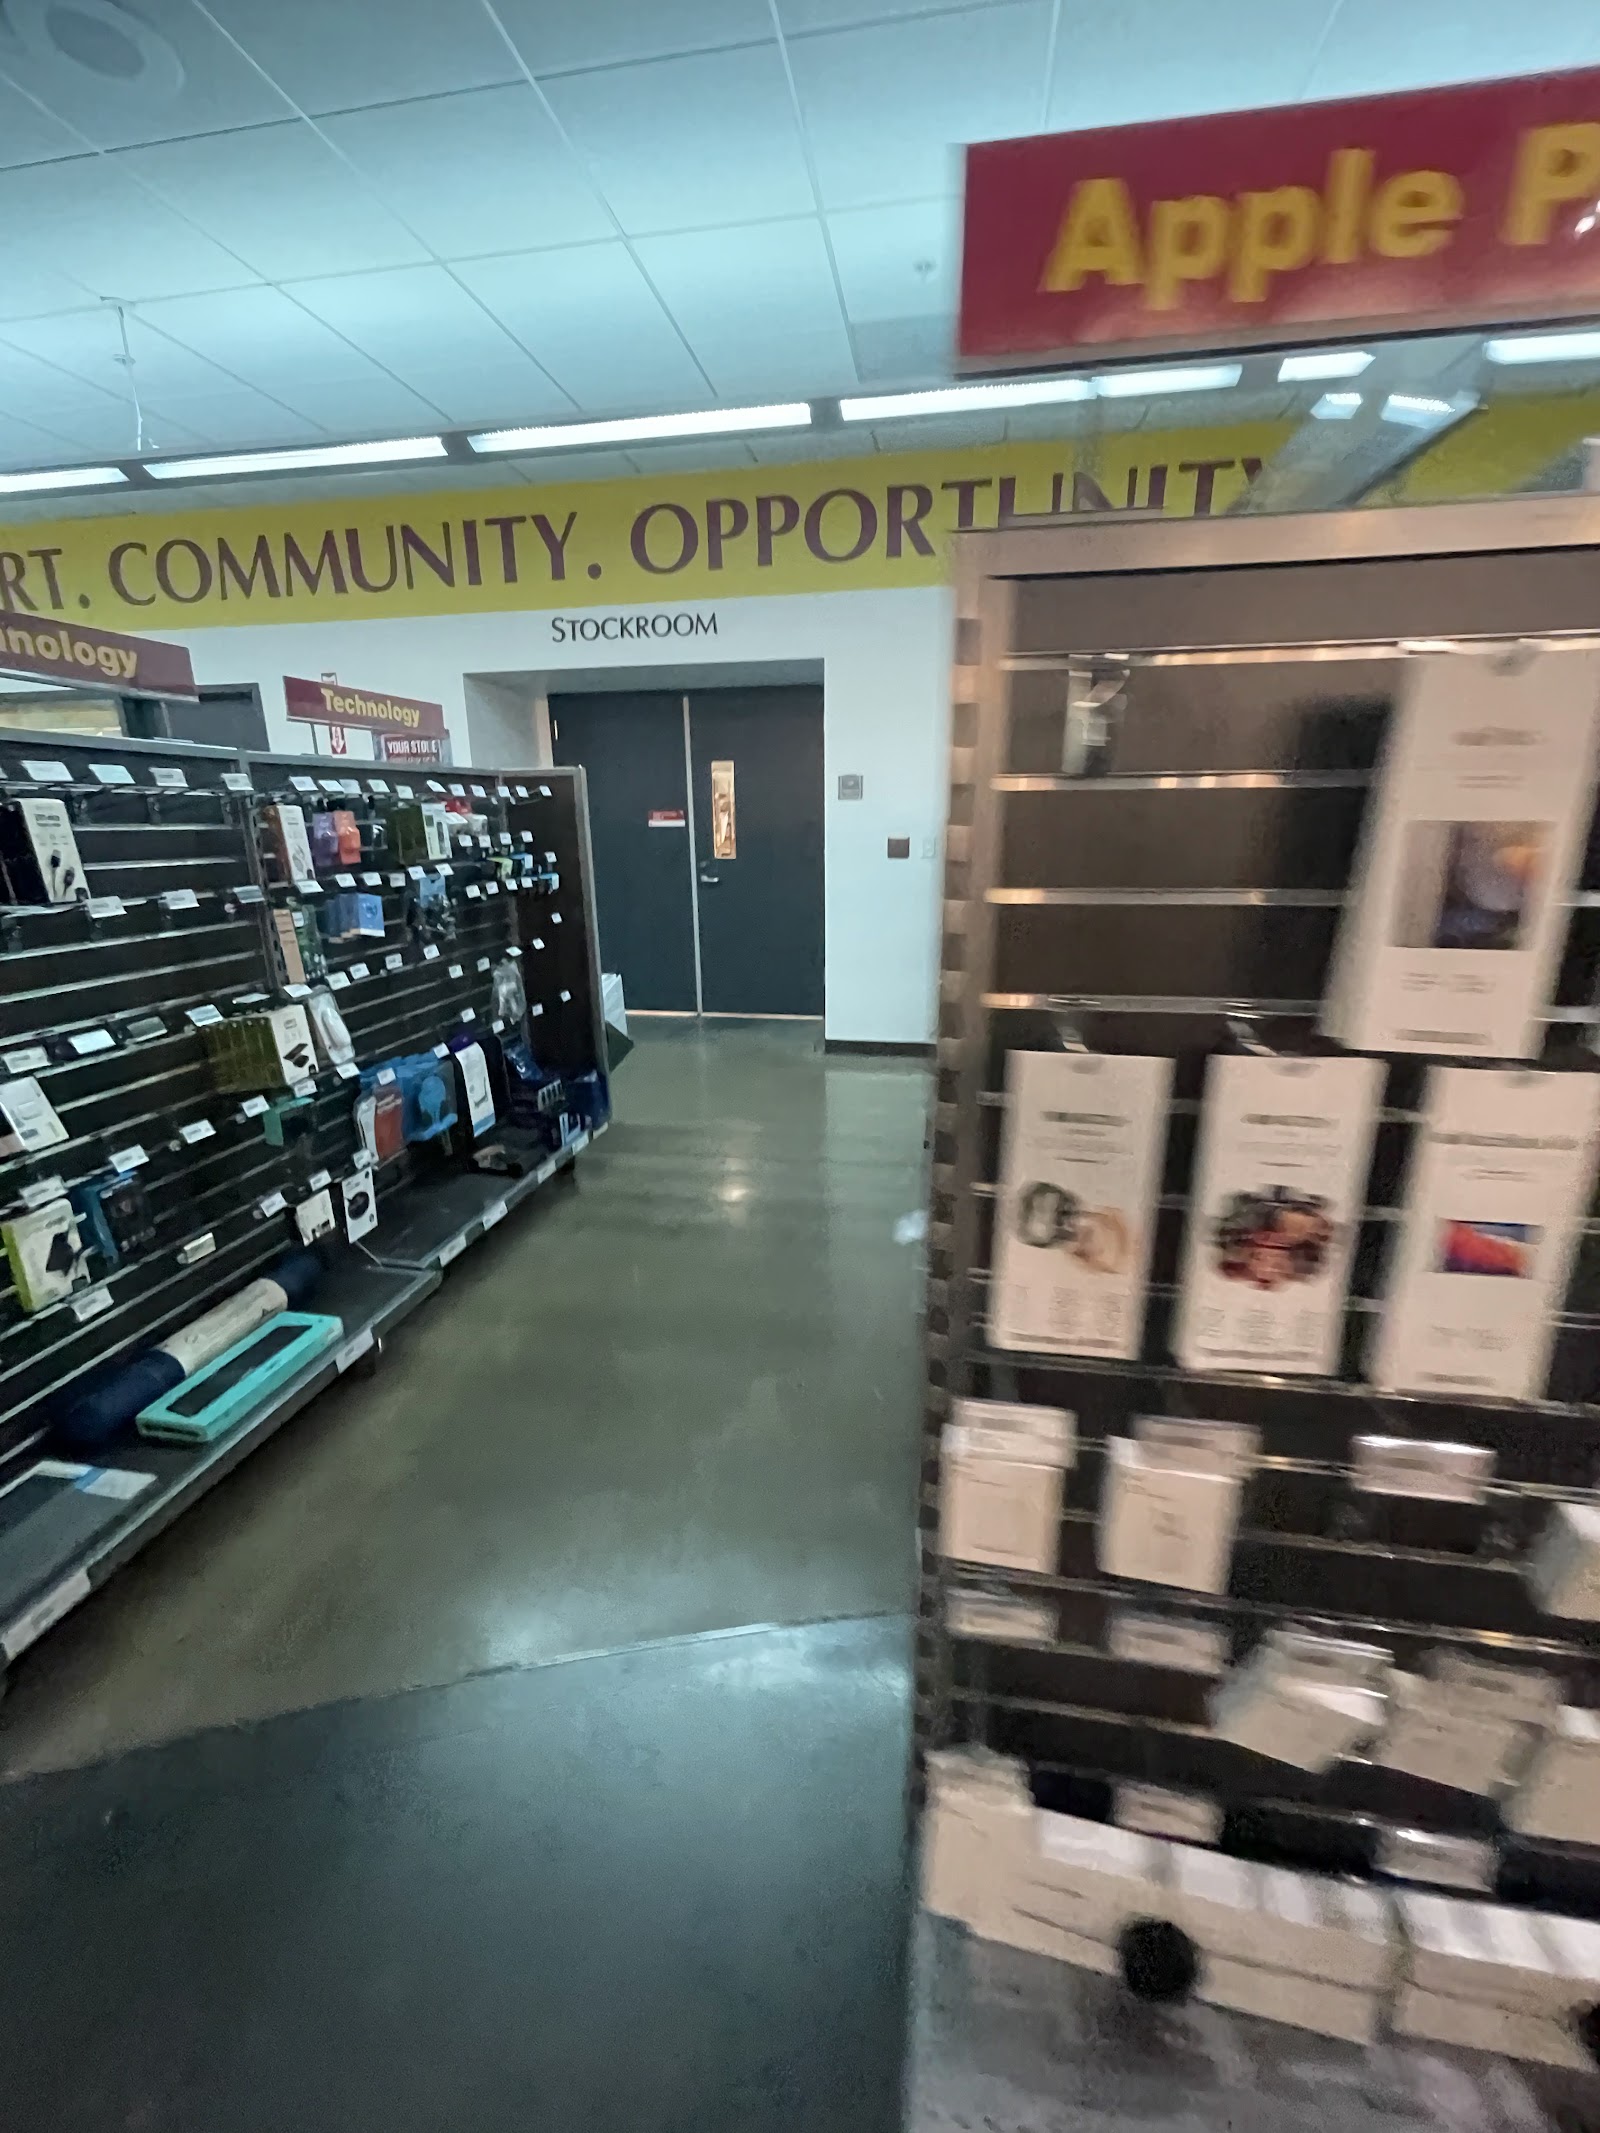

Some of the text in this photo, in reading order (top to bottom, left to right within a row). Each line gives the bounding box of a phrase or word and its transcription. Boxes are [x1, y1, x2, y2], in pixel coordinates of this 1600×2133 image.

[1043, 122, 1600, 311] Apple P
[0, 548, 91, 613] RT.
[108, 511, 602, 607] COMMUNITY.
[0, 624, 138, 679] nology
[551, 611, 718, 643] STOCKROOM
[320, 687, 420, 728] Technology
